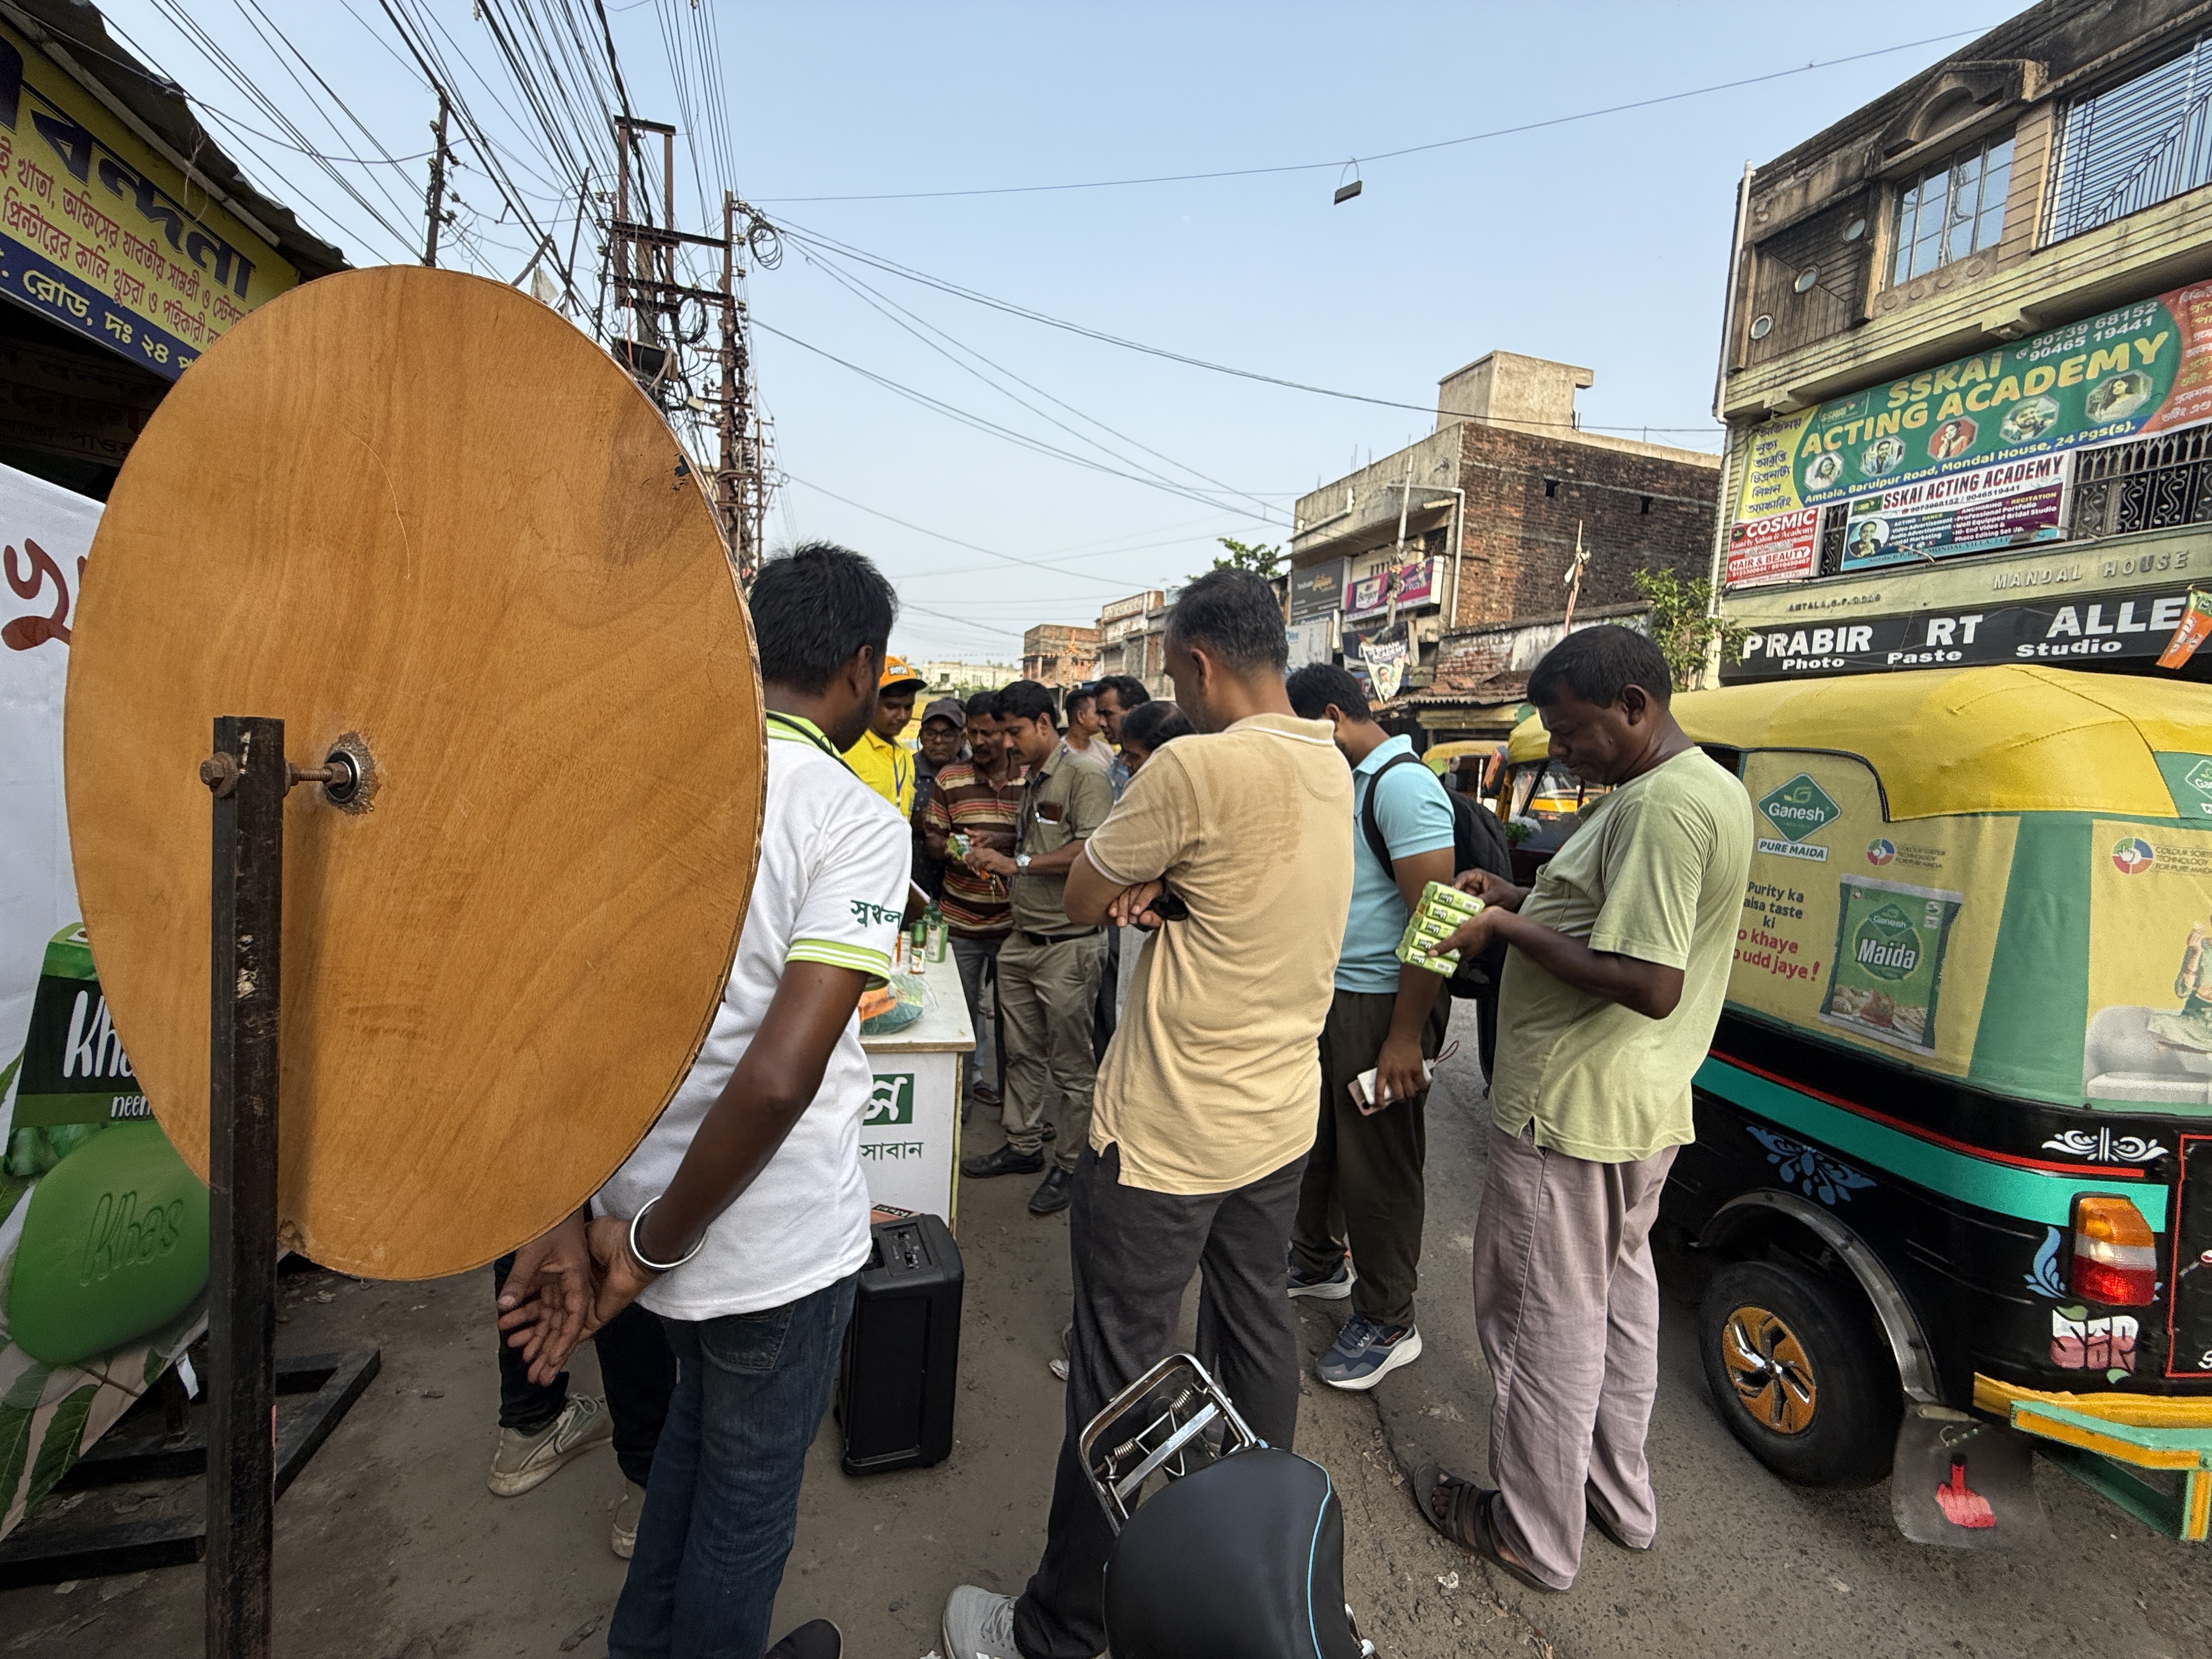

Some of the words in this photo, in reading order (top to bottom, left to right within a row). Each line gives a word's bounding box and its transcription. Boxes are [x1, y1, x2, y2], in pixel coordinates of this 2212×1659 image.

[63, 187, 120, 250] অফিসের
[123, 230, 166, 282] যাবতীয়
[167, 262, 200, 302] সামগ্রী
[202, 289, 210, 309] ও
[2, 185, 72, 262] প্রিন্টারের
[75, 241, 110, 284] কালি
[114, 268, 145, 308] খুচরা
[149, 292, 158, 313] ও
[163, 300, 206, 343] পাইকারী
[2029, 335, 2086, 362] 90465
[2093, 315, 2153, 342] 19441
[2032, 323, 2089, 349] 90739
[2095, 301, 2158, 329] 68152
[141, 334, 169, 364] ২৪
[1801, 400, 1928, 458] ACTING
[1936, 330, 2169, 422] ACADEMY
[1887, 351, 2002, 408] SSKAI
[1805, 487, 1846, 504] Amtala,
[1848, 475, 1901, 493] Baruipur
[1903, 465, 1938, 482] Road,
[1941, 452, 1994, 472] Mondal
[1998, 440, 2052, 460] House,
[2055, 435, 2073, 448] 24
[1883, 486, 1924, 510] SSKAI
[1926, 473, 1980, 501] ACTING
[1982, 454, 2065, 489] ACADEMY
[1747, 509, 1816, 538] COSMIC
[1731, 558, 1754, 569] HAIR
[1765, 548, 1808, 561] BEAUTY
[1993, 563, 2083, 590] MANDAL
[2103, 549, 2189, 578] HOUSE
[1742, 625, 1874, 659] PRABIR
[1781, 657, 1846, 671] Photo
[1887, 649, 1962, 665] Paste
[1768, 802, 1825, 823] Ganesh
[1759, 840, 1788, 853] PURE
[1789, 845, 1824, 859] MAIDA
[1747, 881, 1785, 901] Purity
[1787, 888, 1804, 904] ka
[1763, 915, 1776, 929] ki
[1769, 902, 1803, 919] taste
[1750, 928, 1799, 955] khaye
[1857, 938, 1916, 970] Maida
[1742, 950, 1772, 969] udd
[859, 1141, 925, 1161] সাবান
